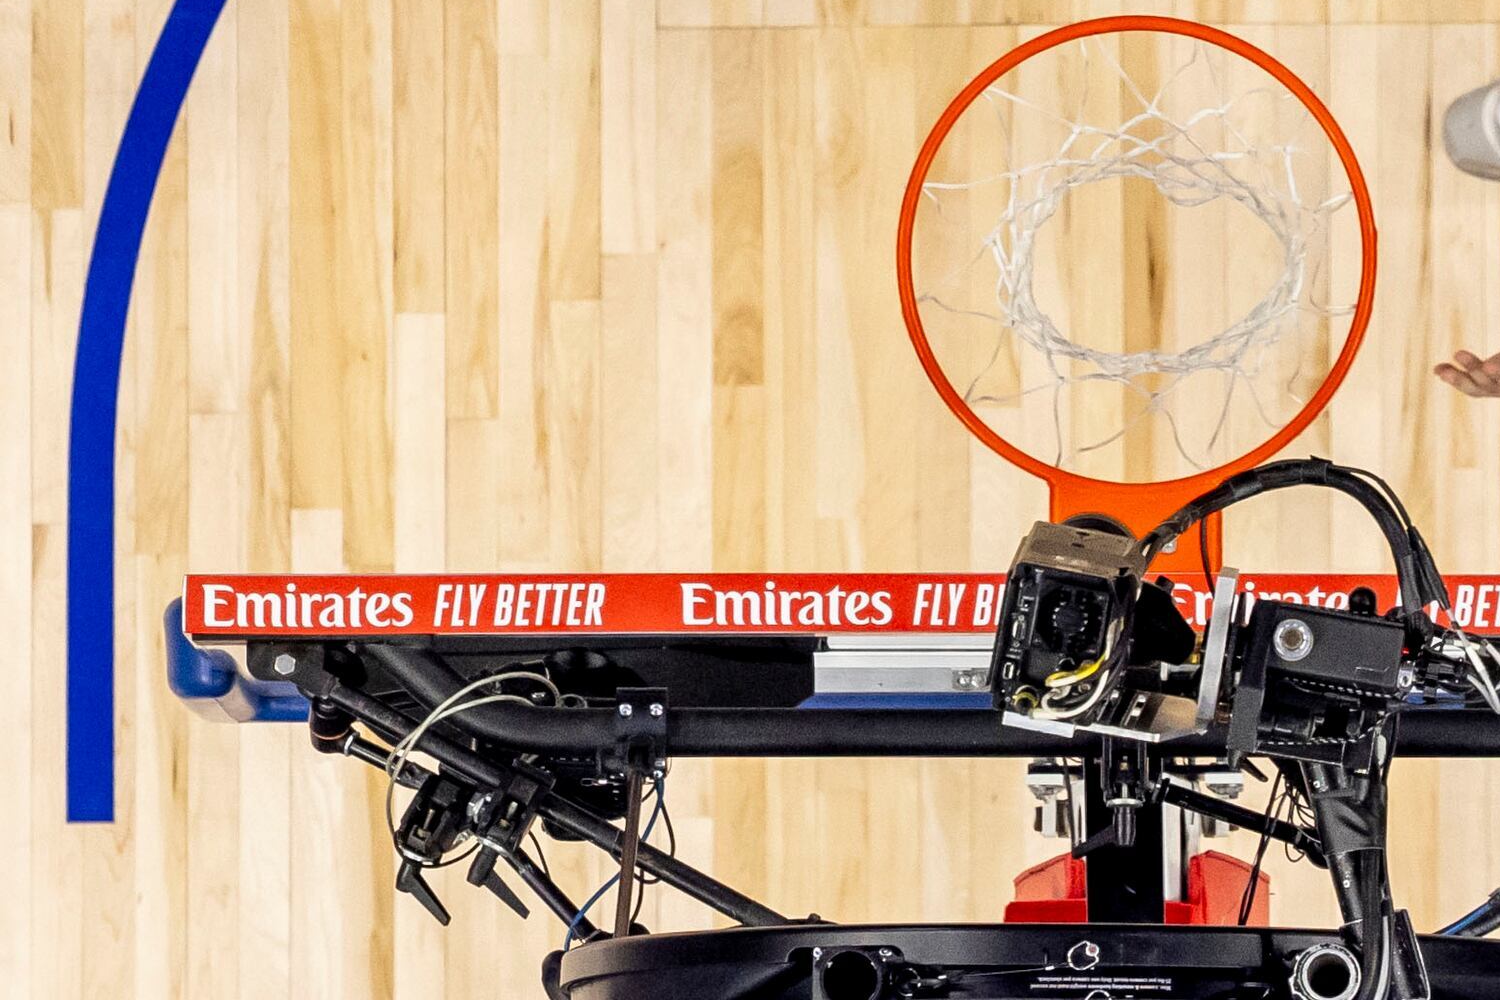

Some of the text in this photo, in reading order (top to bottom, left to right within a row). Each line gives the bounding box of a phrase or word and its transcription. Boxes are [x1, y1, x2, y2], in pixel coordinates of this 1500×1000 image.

[202, 583, 606, 627] Emirates FLY BETTER
[680, 581, 893, 627] Emirates
[912, 583, 967, 626] FLY
